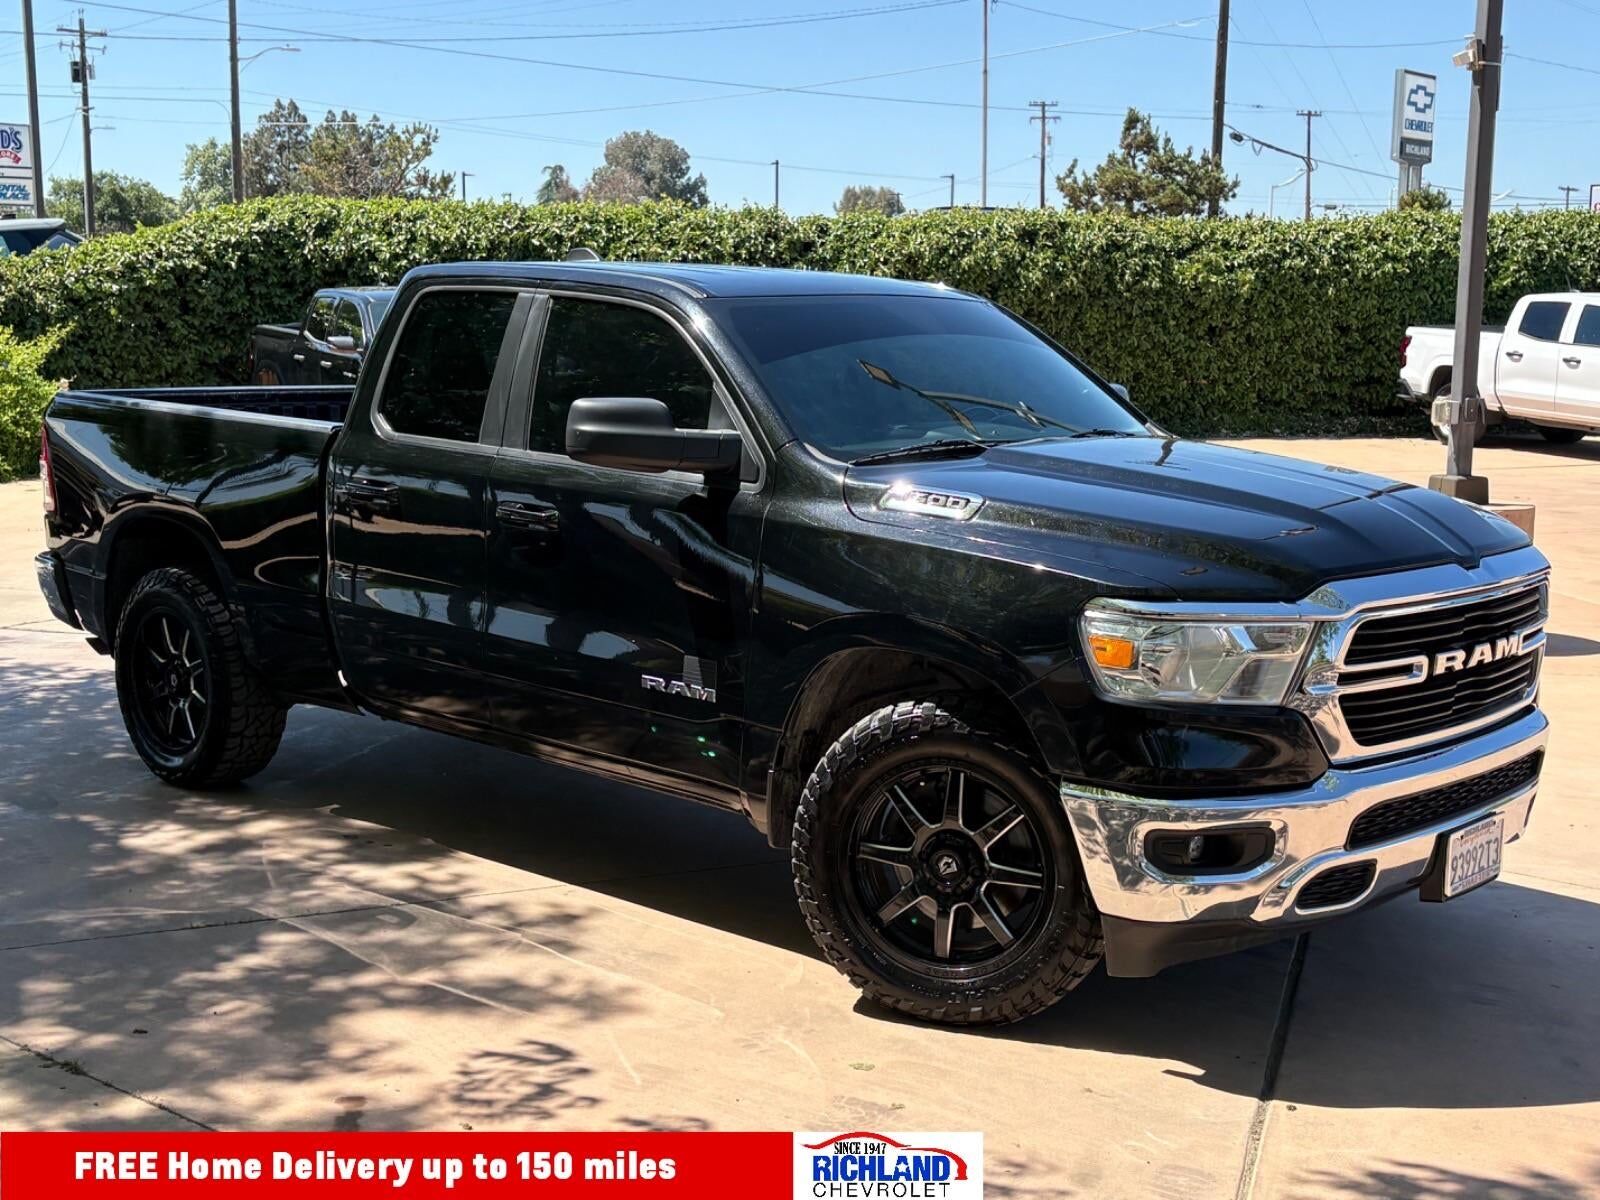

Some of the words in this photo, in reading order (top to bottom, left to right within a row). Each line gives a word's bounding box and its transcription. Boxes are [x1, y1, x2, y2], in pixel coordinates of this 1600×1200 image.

[1433, 634, 1520, 676] RAM
[641, 674, 716, 703] RAM
[1451, 837, 1500, 886] 93992T3
